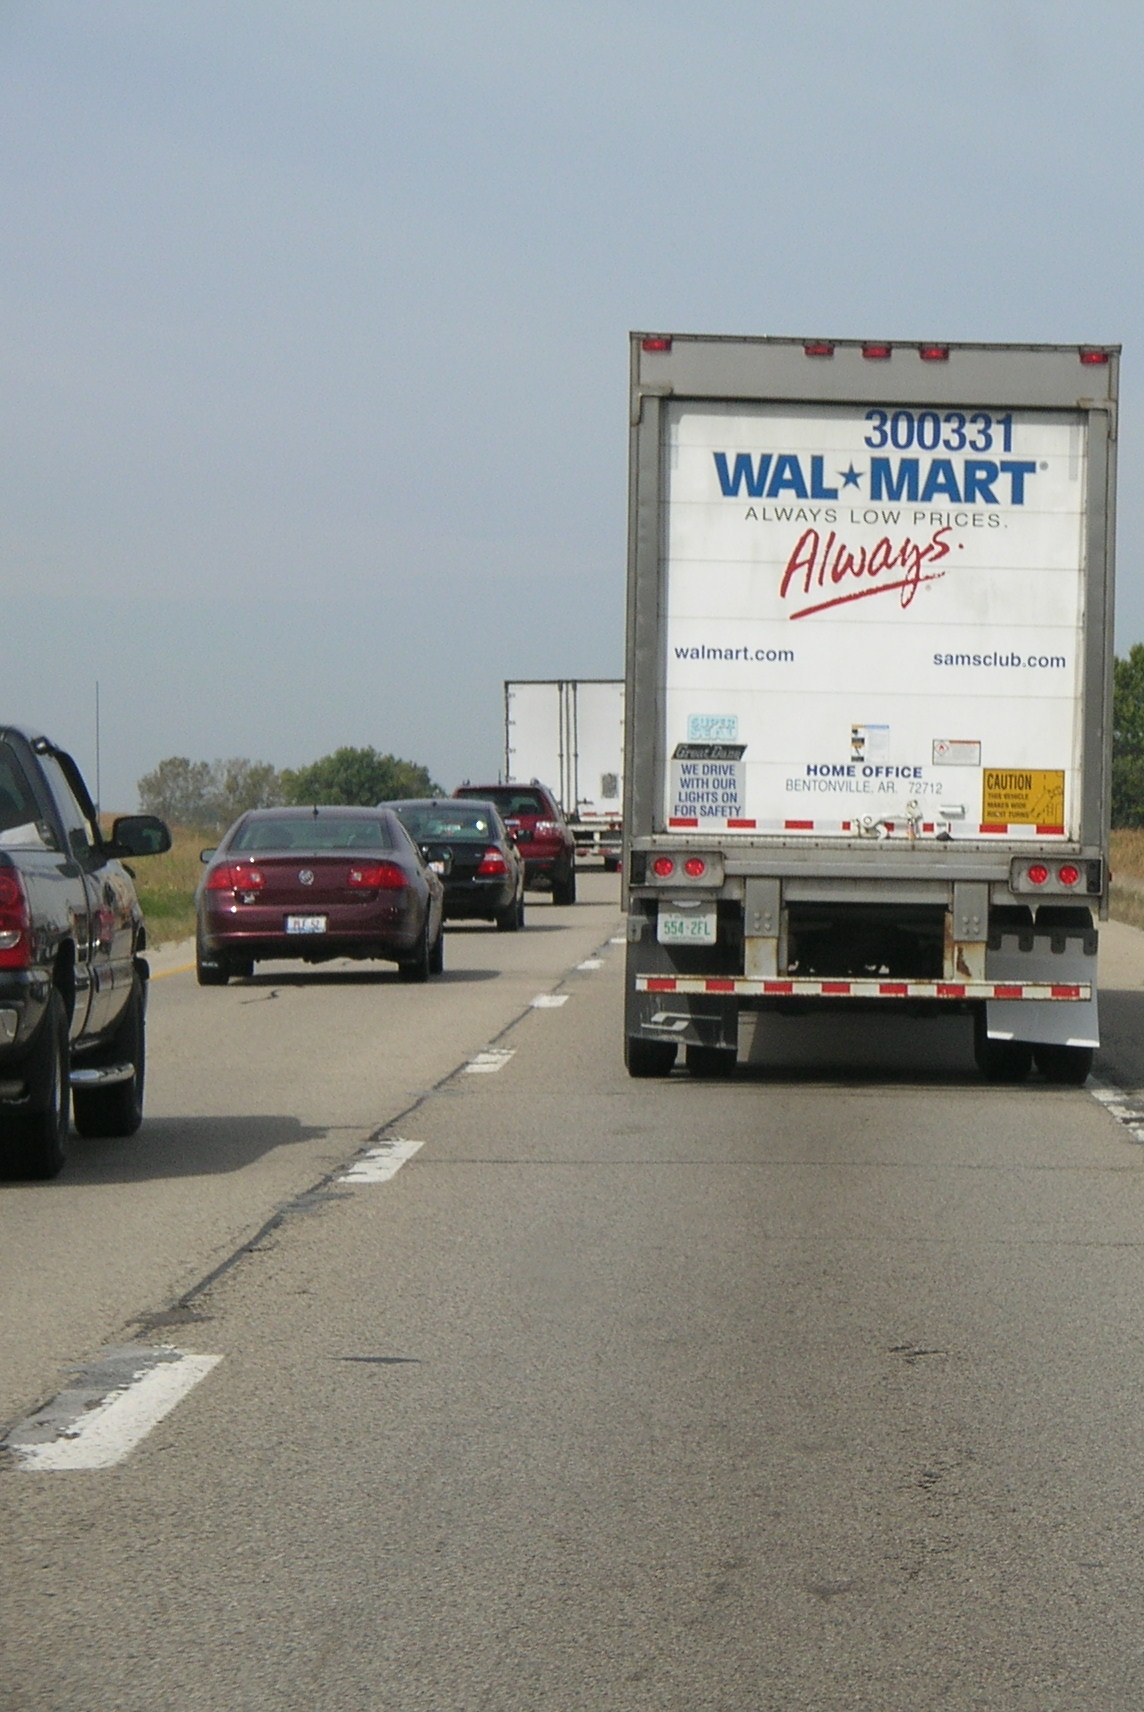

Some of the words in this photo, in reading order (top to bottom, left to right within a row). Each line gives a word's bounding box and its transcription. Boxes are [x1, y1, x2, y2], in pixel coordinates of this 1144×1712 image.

[863, 408, 1014, 453] 300331
[744, 506, 838, 523] ALWAYS
[850, 509, 901, 525] LOW
[913, 511, 1009, 529] PRICES.
[674, 644, 795, 662] walmart.com
[933, 652, 1067, 668] samsclub.com
[681, 763, 699, 775] WE
[702, 764, 736, 776] DRIVE
[806, 765, 856, 777] HOME
[862, 766, 922, 779] OFFICE
[680, 778, 709, 789] WITH
[712, 778, 736, 789] OUR
[785, 779, 874, 794] BENTONVILLE,
[908, 782, 943, 795] 72712
[987, 773, 1032, 790] CAUTION
[678, 791, 718, 803] LIGHTS
[721, 792, 738, 803] ON
[674, 805, 697, 816] FOR
[700, 805, 742, 817] SAFETY
